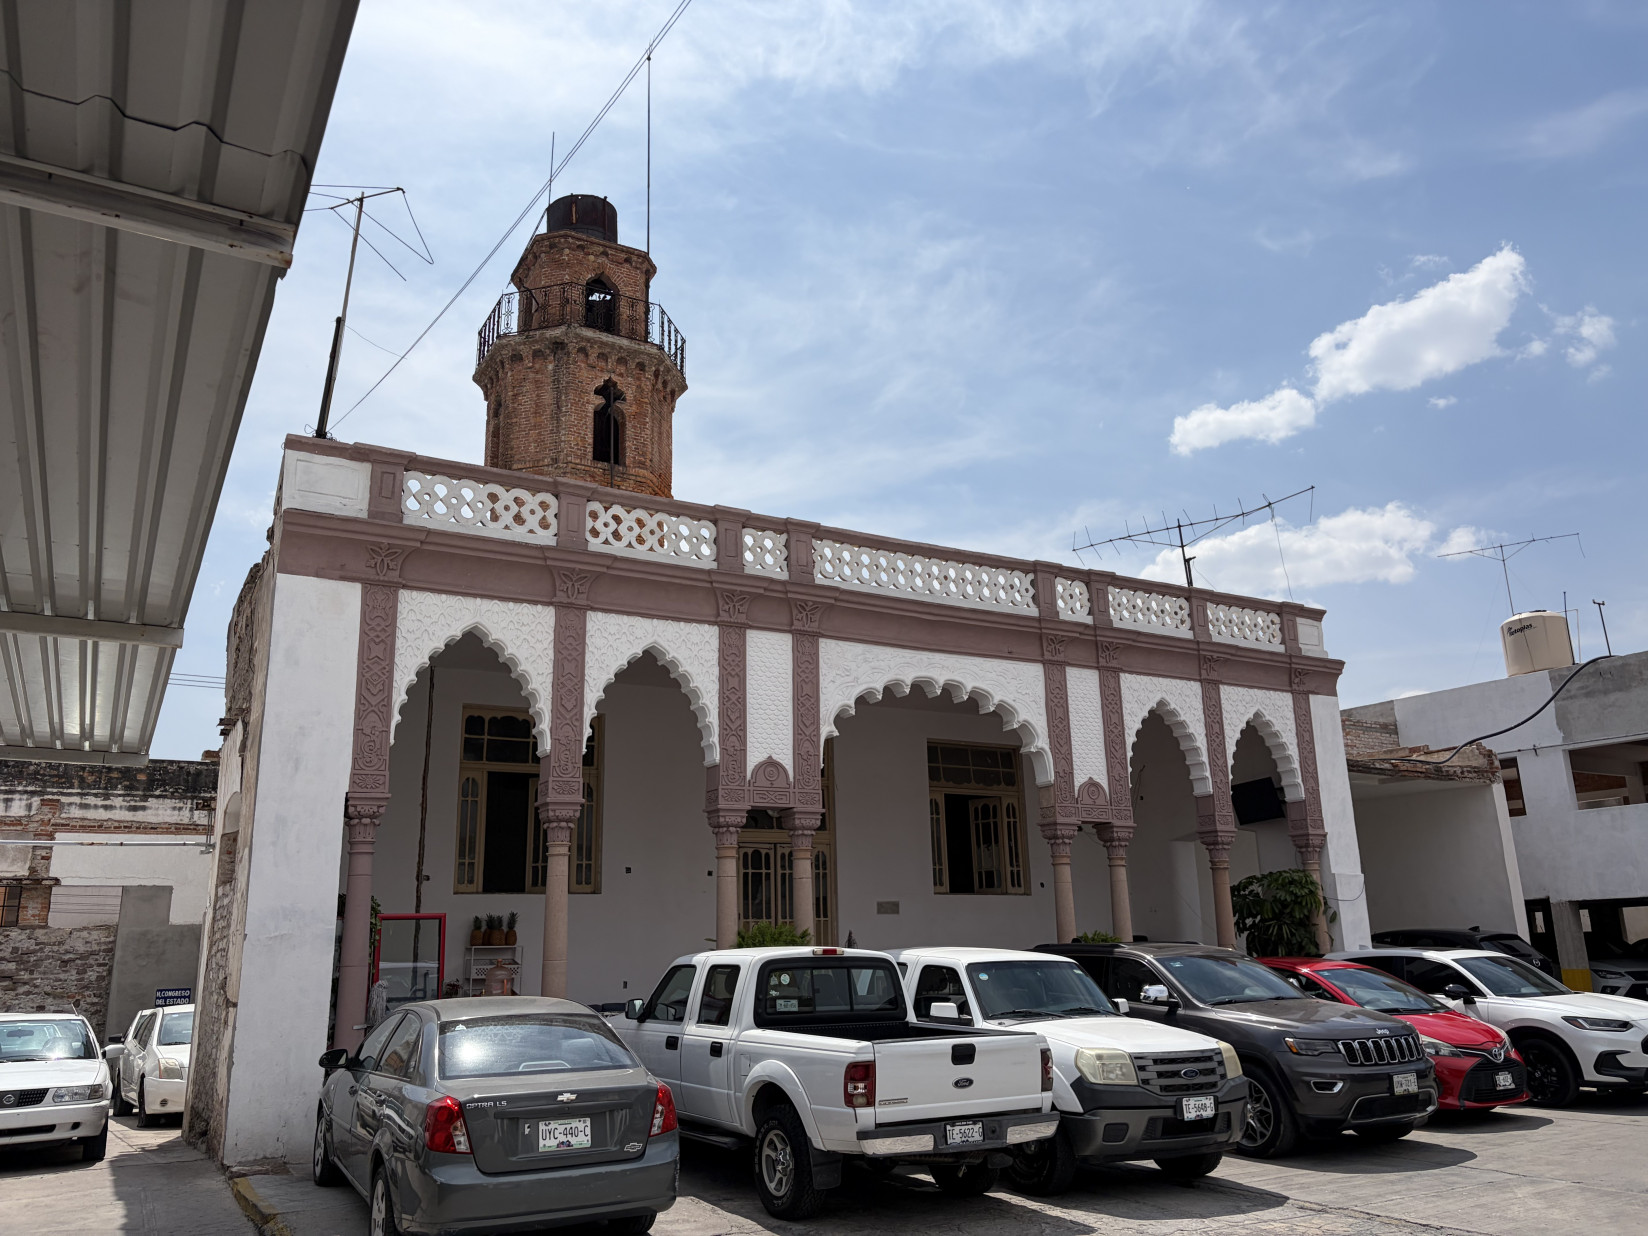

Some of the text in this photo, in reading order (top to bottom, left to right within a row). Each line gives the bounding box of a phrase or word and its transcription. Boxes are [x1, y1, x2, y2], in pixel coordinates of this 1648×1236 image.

[466, 1101, 494, 1109] OPTRA
[541, 1125, 589, 1141] UYC-440-C
[947, 1126, 983, 1140] TE-5622-G
